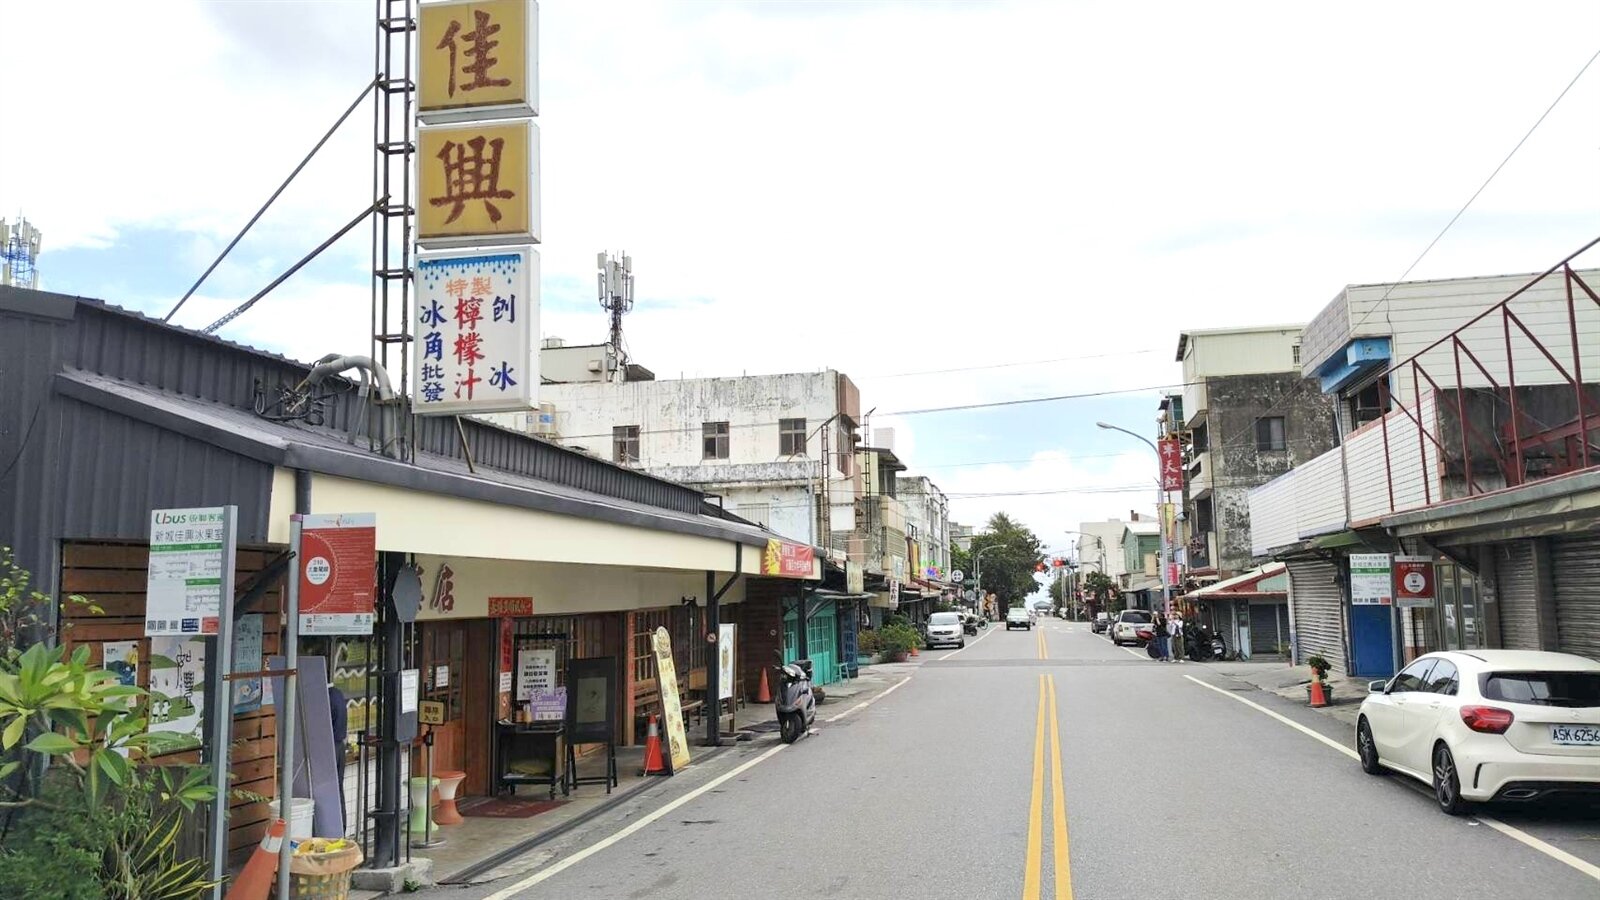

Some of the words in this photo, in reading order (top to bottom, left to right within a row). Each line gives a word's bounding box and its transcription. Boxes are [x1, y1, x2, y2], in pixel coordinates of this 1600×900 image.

[445, 276, 494, 298] 特製
[453, 297, 486, 400] 檸檬汁
